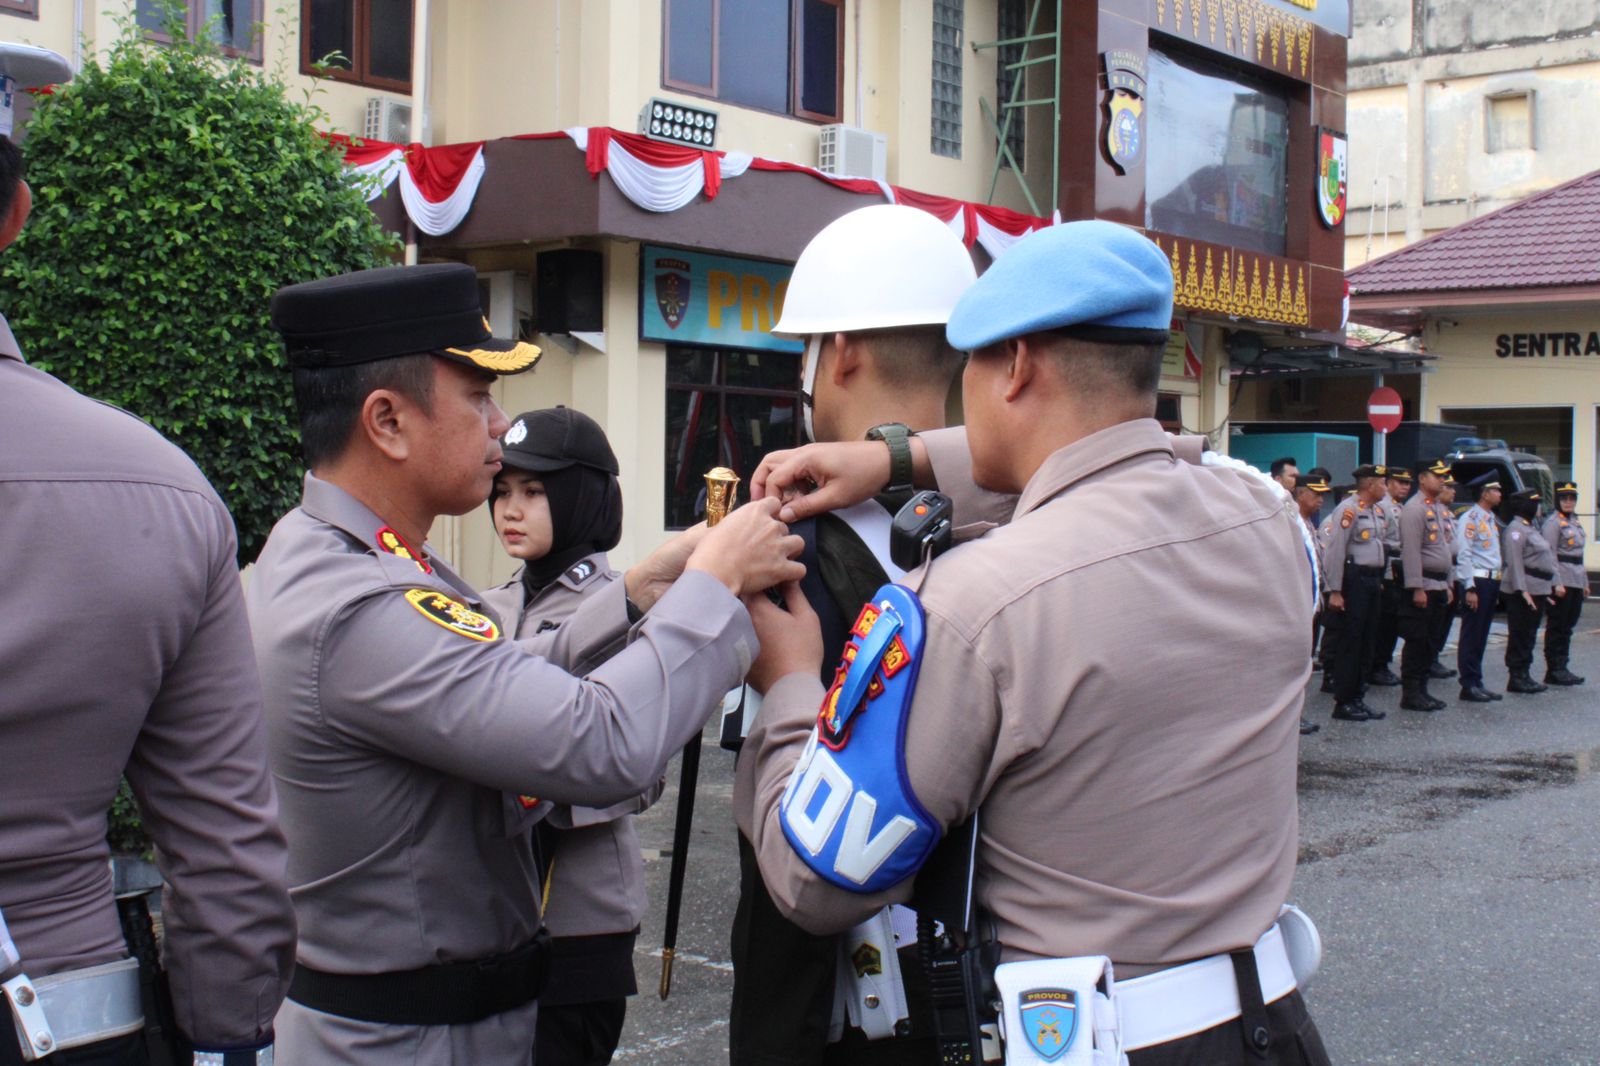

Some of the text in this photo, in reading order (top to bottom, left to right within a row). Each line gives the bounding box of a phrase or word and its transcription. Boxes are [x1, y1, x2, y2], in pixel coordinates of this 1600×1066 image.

[1113, 75, 1144, 92] RIAU
[1496, 332, 1600, 358] SENTRA
[1028, 992, 1068, 1000] PROVOS
